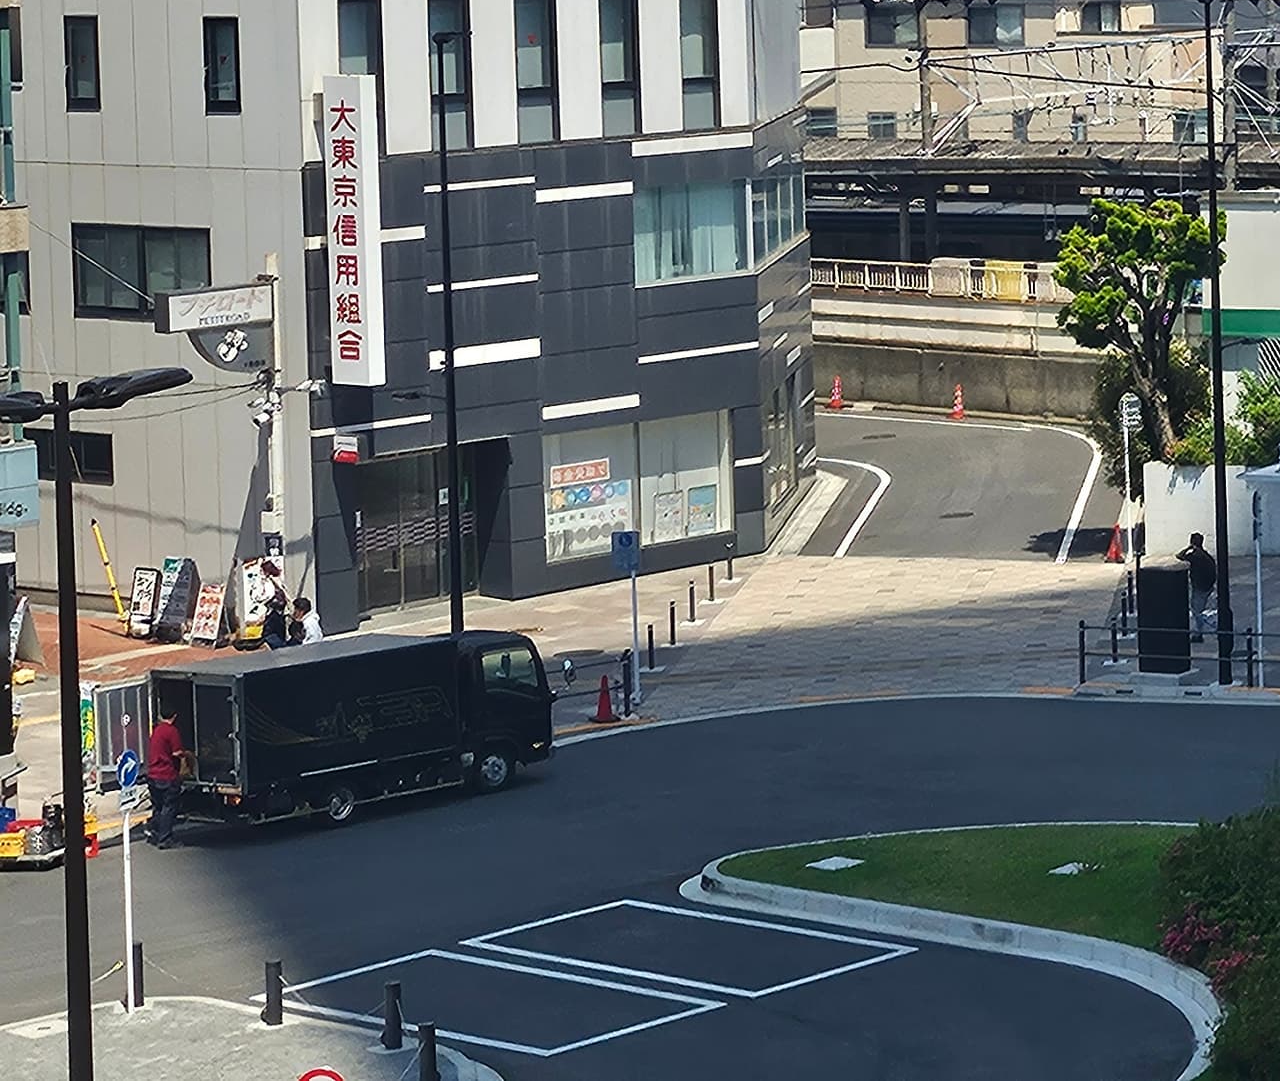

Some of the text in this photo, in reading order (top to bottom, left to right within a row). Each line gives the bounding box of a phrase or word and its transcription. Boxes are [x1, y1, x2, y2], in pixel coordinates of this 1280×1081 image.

[330, 99, 362, 361] 大東京信用組合
